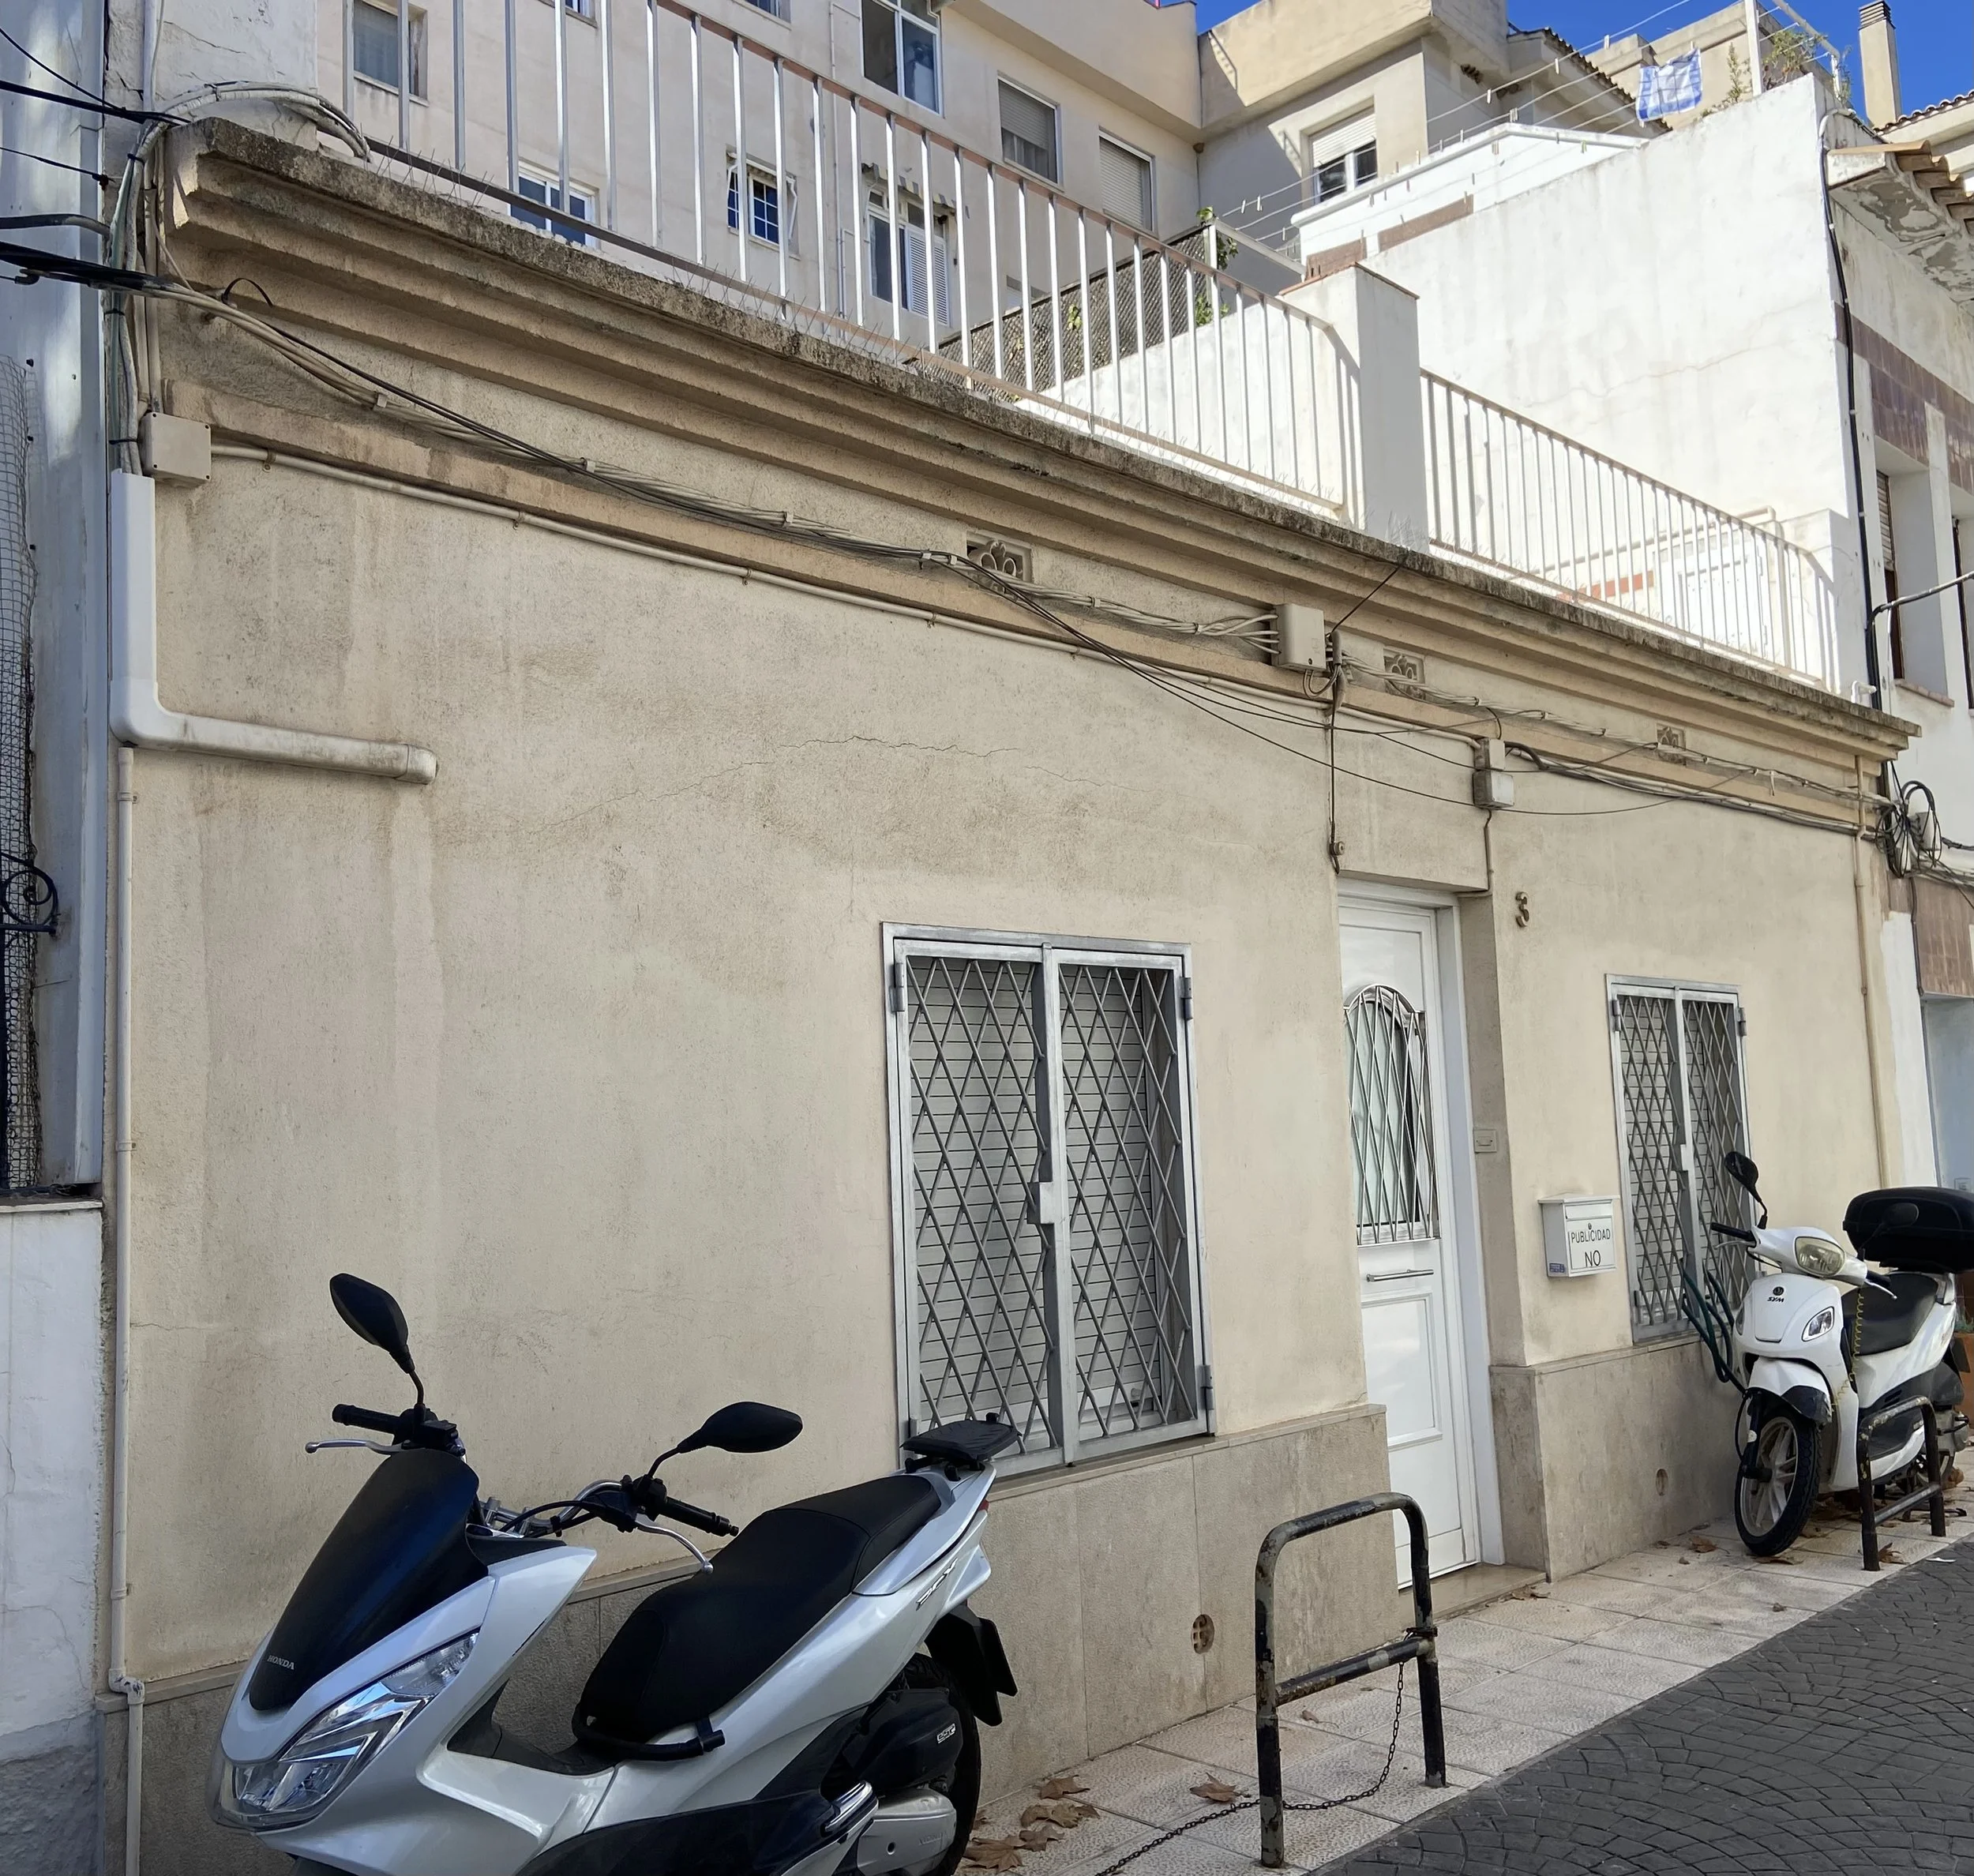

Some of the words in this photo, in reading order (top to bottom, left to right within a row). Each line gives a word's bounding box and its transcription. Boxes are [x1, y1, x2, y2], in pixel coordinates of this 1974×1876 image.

[1515, 891, 1529, 928] 3
[1571, 1229, 1611, 1244] PUBLICIDAD
[1584, 1250, 1601, 1267] NO
[267, 1655, 295, 1670] HONDA
